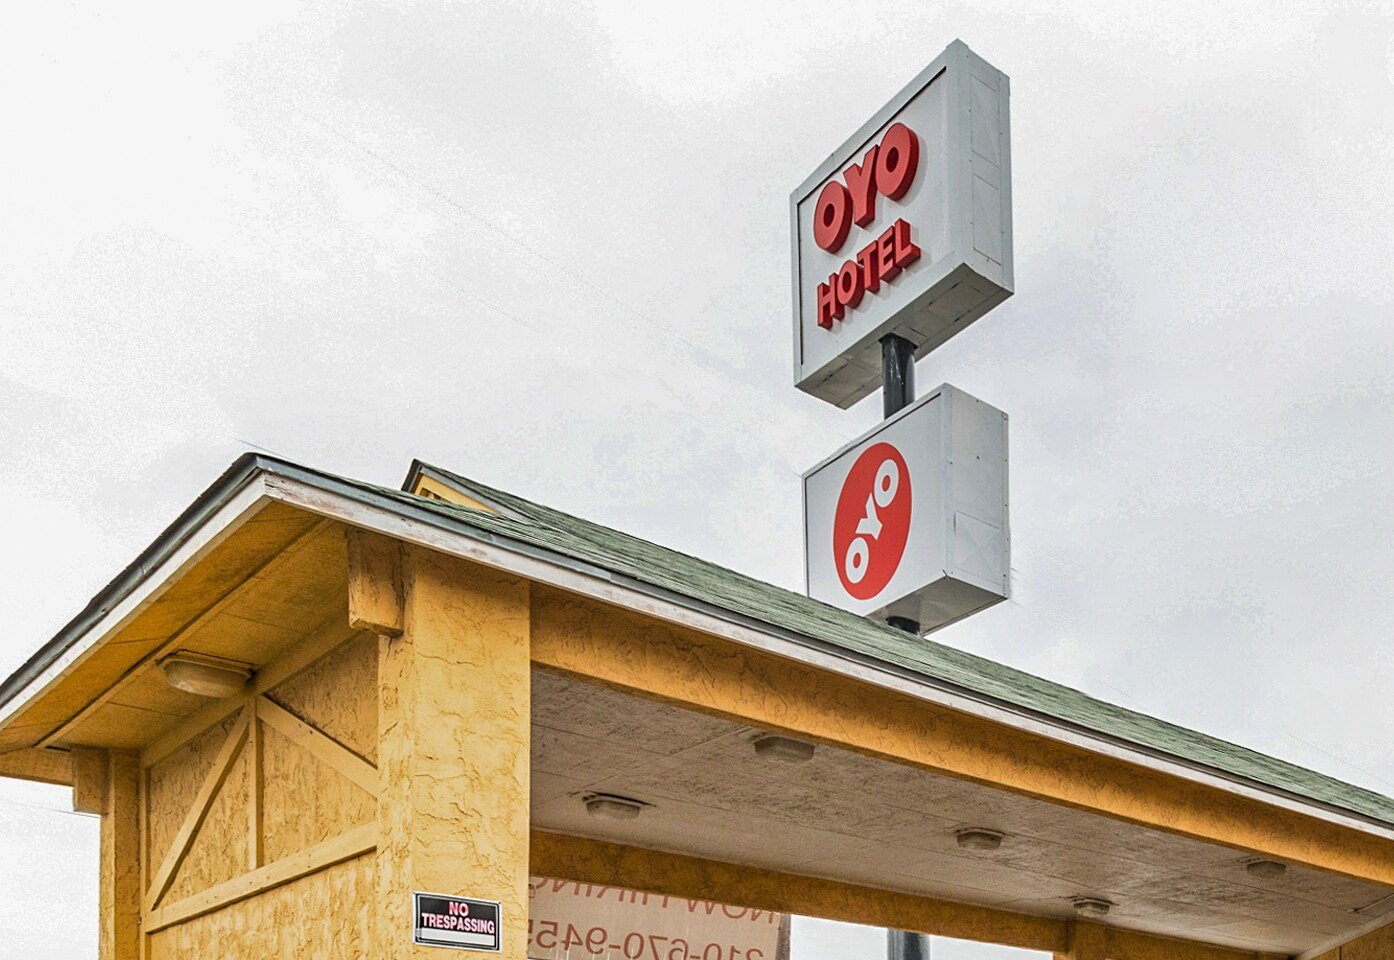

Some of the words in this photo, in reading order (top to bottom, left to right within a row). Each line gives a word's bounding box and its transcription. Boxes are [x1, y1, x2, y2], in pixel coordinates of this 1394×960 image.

[813, 122, 919, 254] OYO
[817, 217, 921, 329] HOTEL
[845, 458, 899, 584] OYO
[421, 913, 495, 934] TRESPASSING
[449, 901, 469, 917] NO
